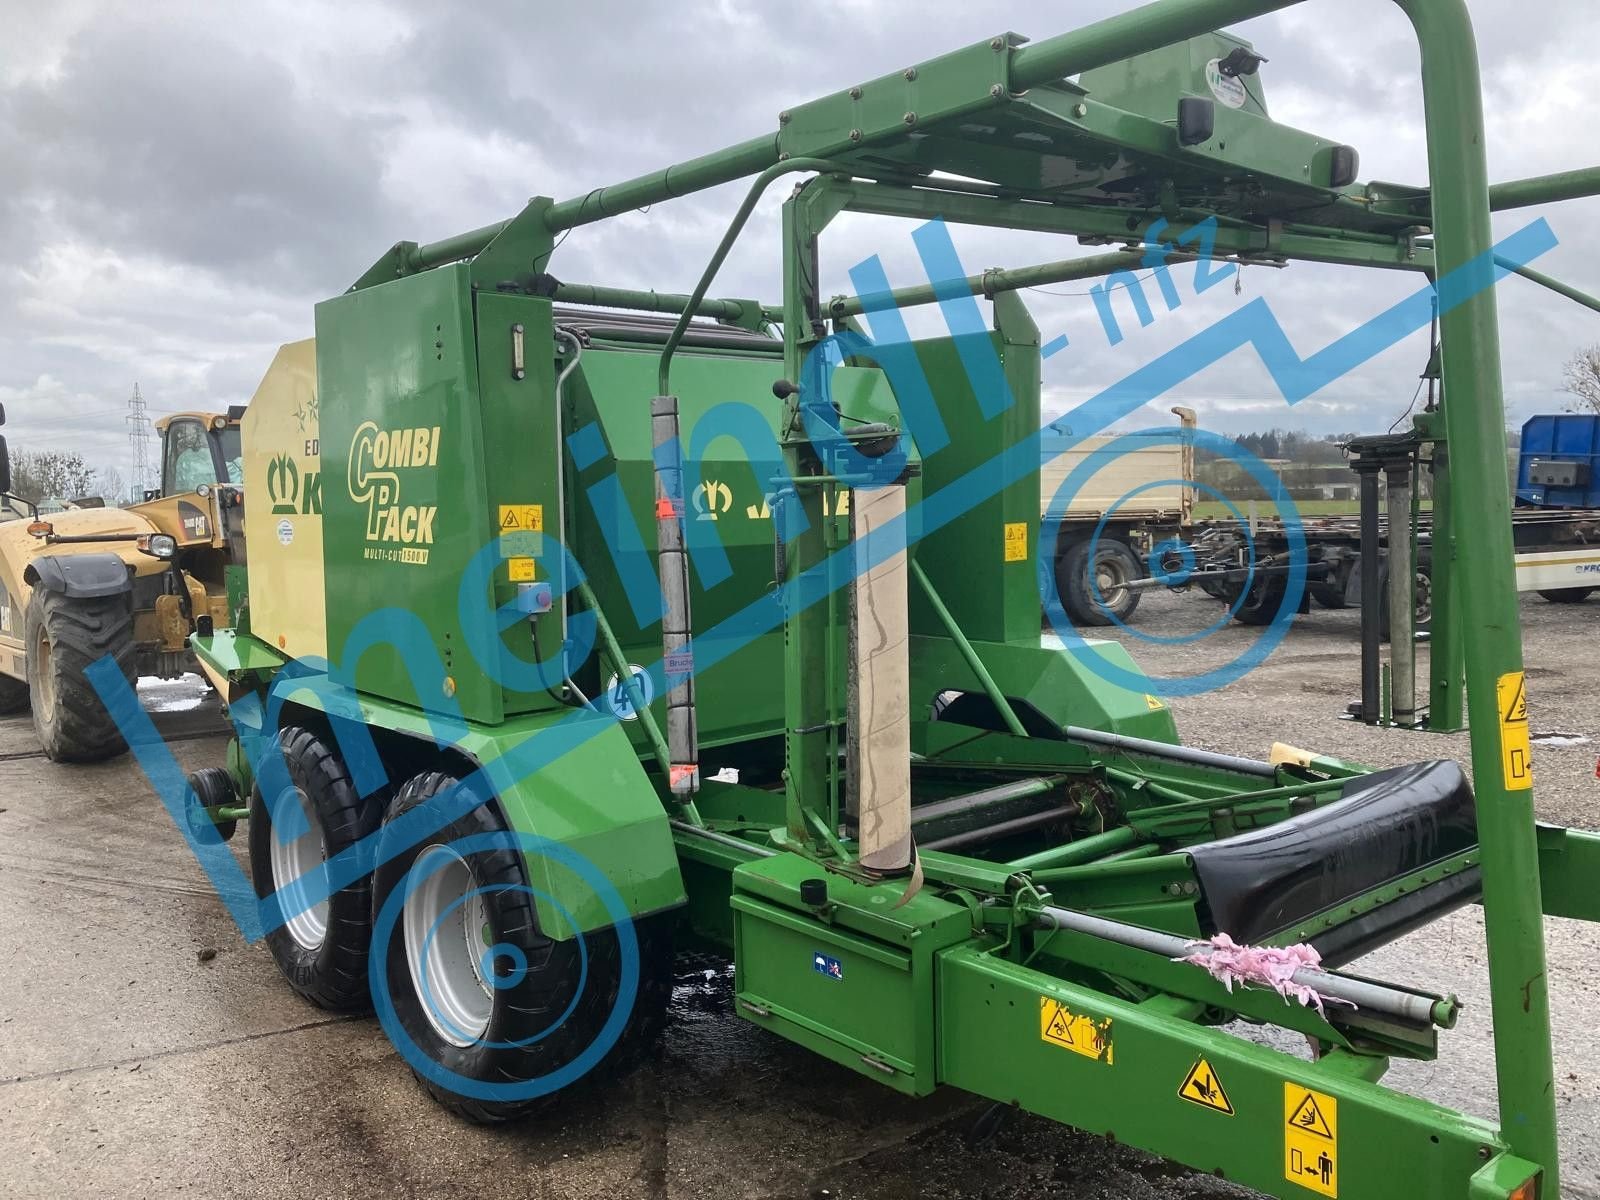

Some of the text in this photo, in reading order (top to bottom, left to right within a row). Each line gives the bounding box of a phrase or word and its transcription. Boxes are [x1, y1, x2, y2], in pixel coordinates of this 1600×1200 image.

[348, 421, 440, 503] COMBI
[366, 471, 437, 544] PACK
[364, 547, 402, 561] MULTI-CUT
